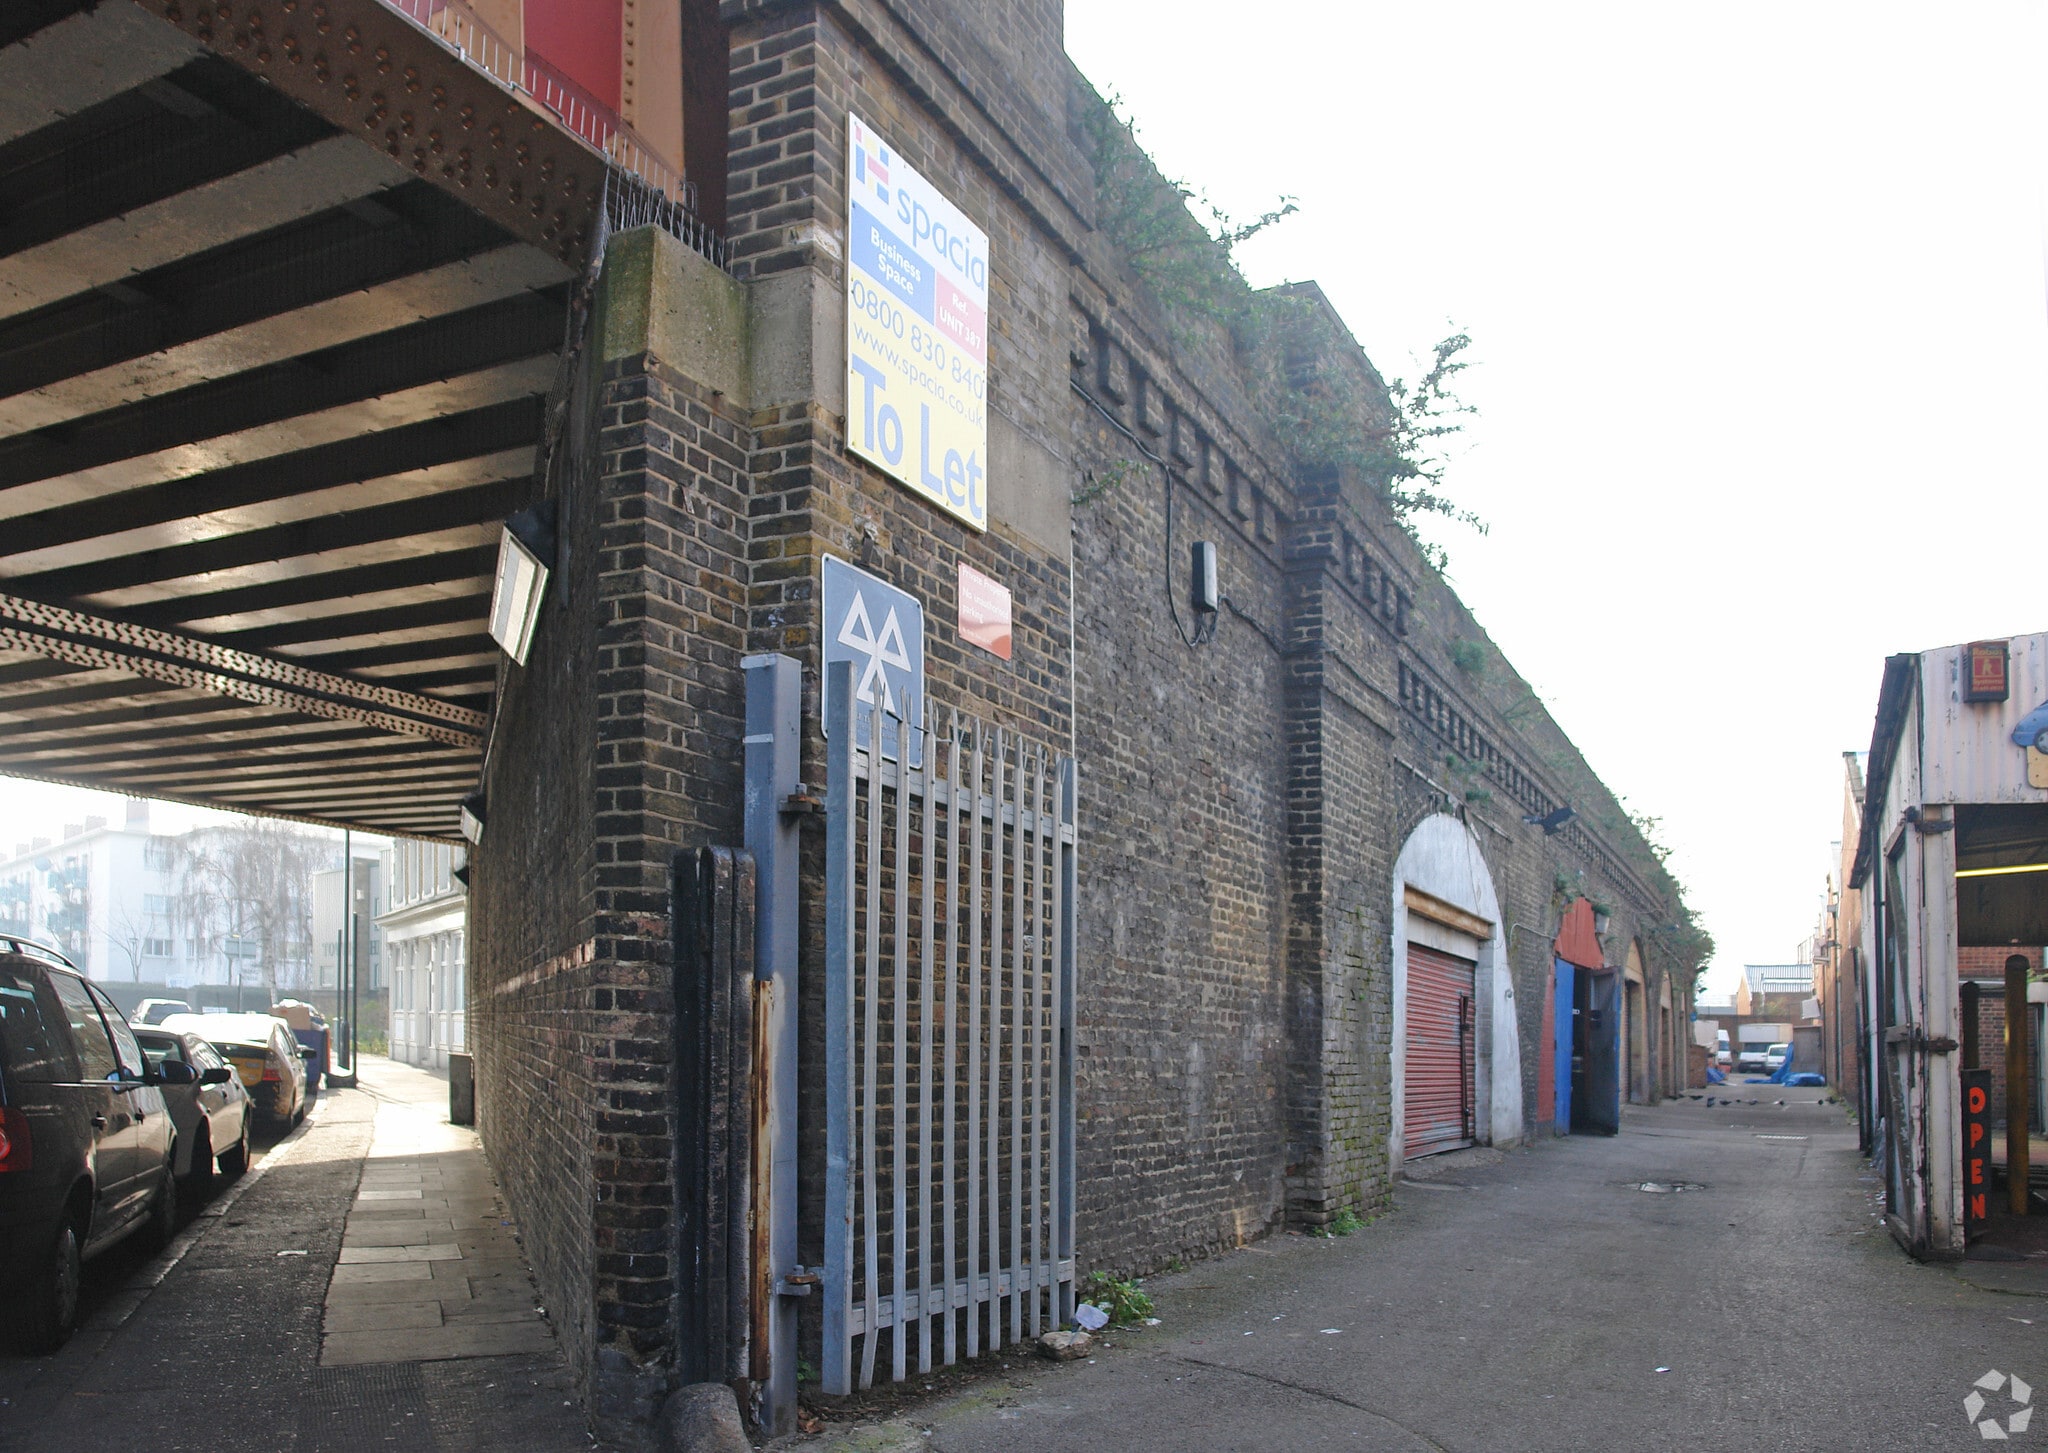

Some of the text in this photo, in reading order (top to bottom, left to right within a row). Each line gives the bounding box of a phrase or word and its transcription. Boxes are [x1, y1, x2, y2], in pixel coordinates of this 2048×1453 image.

[870, 226, 922, 282] Business
[878, 254, 914, 294] Space
[897, 188, 984, 291] spacia
[853, 280, 983, 399] 0800 830 840
[940, 305, 964, 336] UNIT
[854, 321, 984, 431] www.spacia.co.uk
[851, 352, 983, 519] To Let
[1968, 1086, 1987, 1220] OPEN
